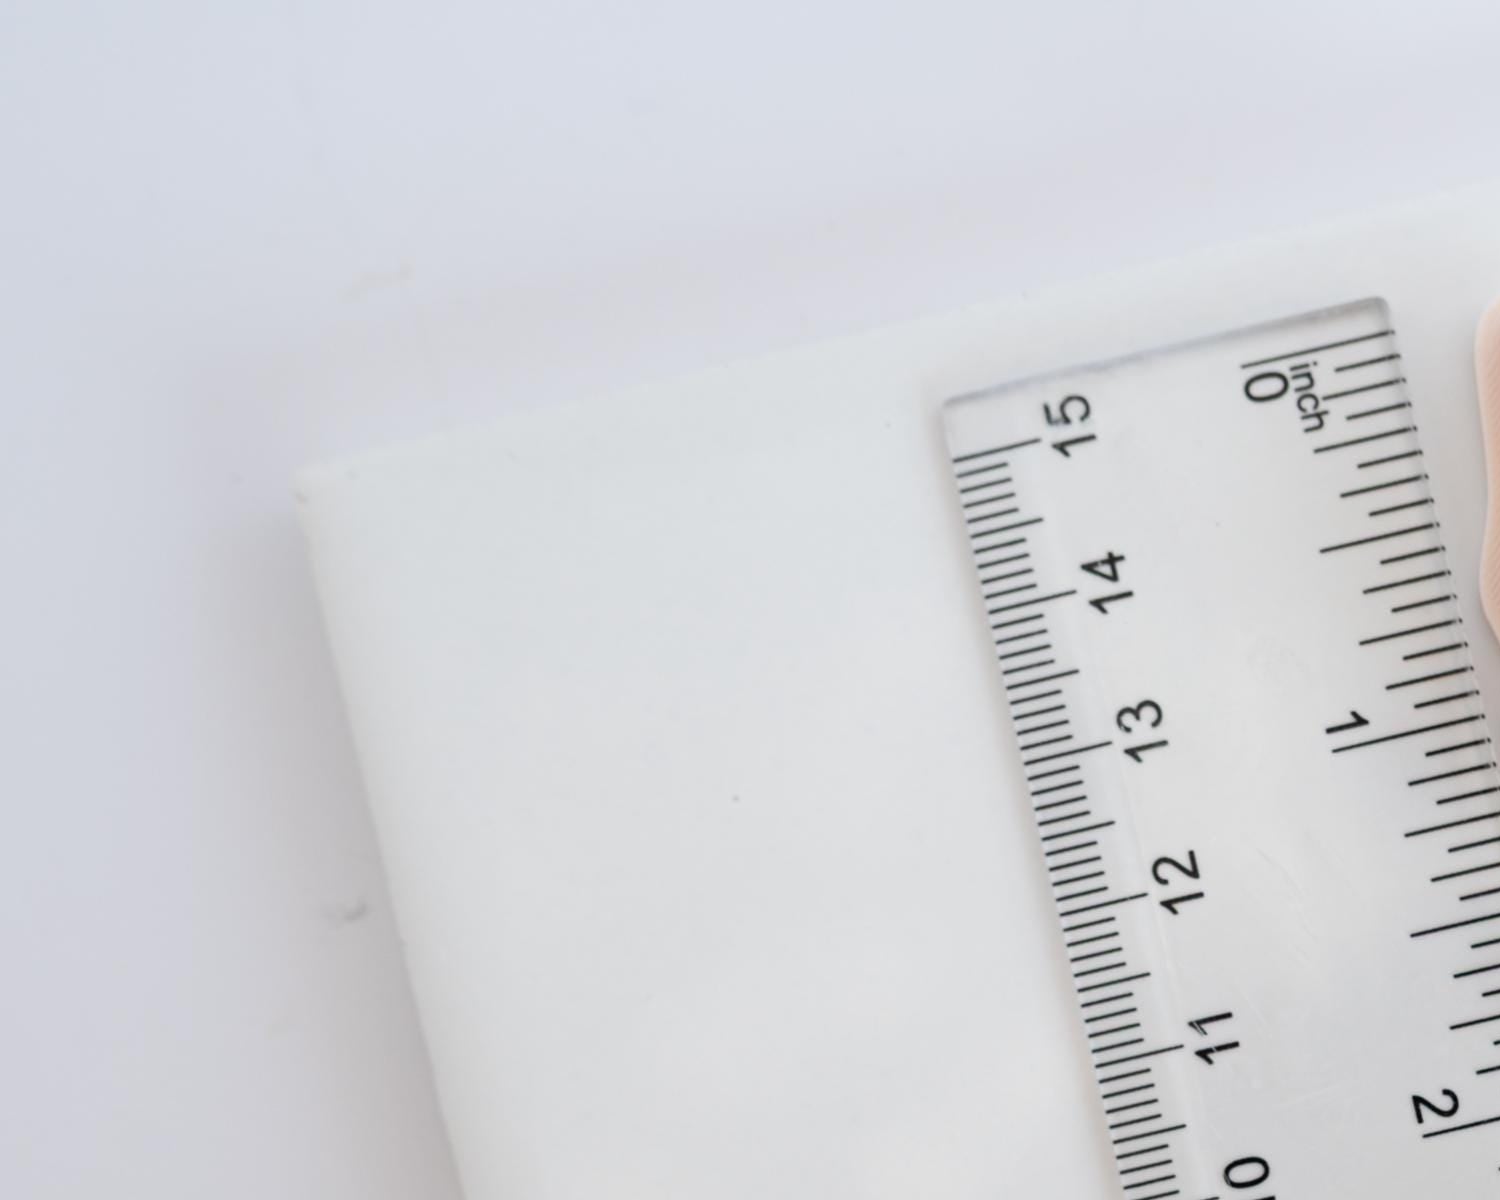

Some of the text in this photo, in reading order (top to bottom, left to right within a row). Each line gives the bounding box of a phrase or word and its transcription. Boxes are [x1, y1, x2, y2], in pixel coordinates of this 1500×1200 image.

[1242, 371, 1290, 404] 0
[1290, 361, 1330, 434] inch
[1042, 394, 1097, 459] 15
[1079, 550, 1135, 615] 14
[1115, 698, 1170, 764] 13
[1324, 710, 1371, 735] 1
[1150, 849, 1205, 916] 12
[1186, 1011, 1241, 1066] 11
[1410, 1087, 1460, 1125] 2
